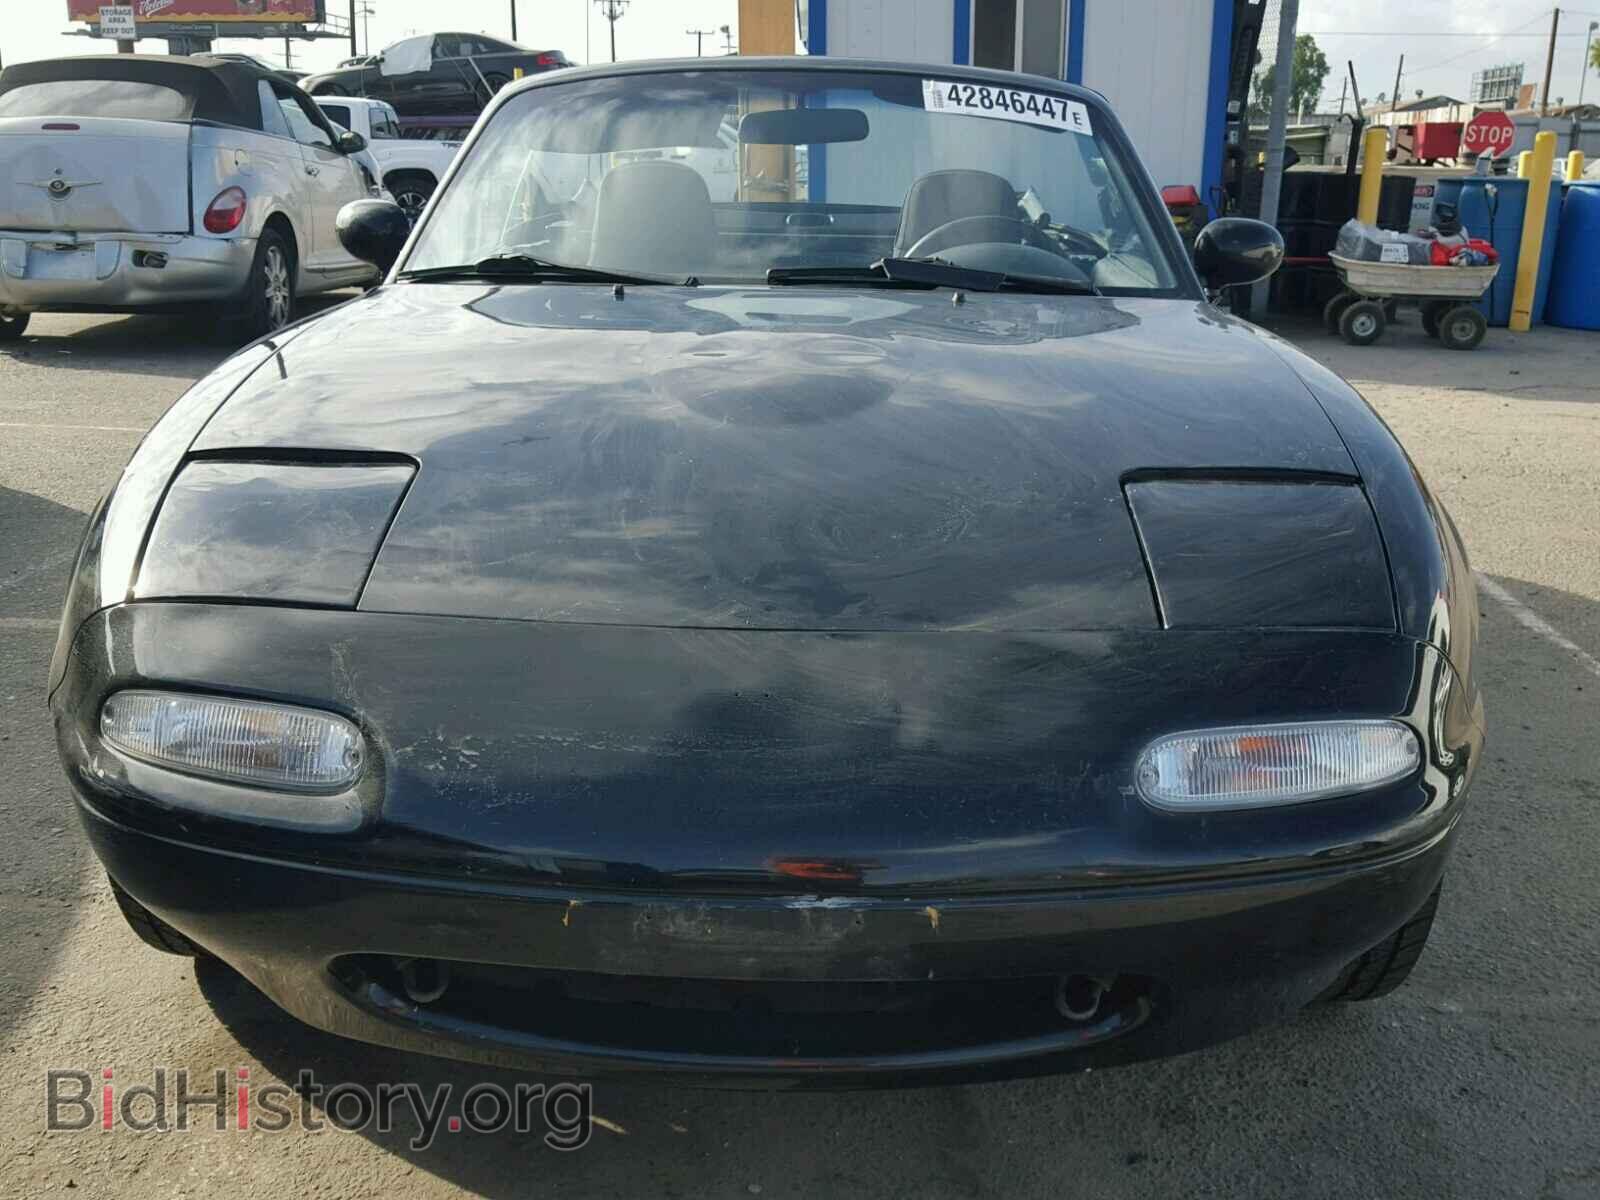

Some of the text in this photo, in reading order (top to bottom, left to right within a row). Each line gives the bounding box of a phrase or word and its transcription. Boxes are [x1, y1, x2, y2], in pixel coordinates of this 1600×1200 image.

[101, 8, 132, 17] STORAGE
[948, 84, 1068, 122] 42846447
[1072, 112, 1083, 126] E
[1466, 125, 1513, 144] STOP
